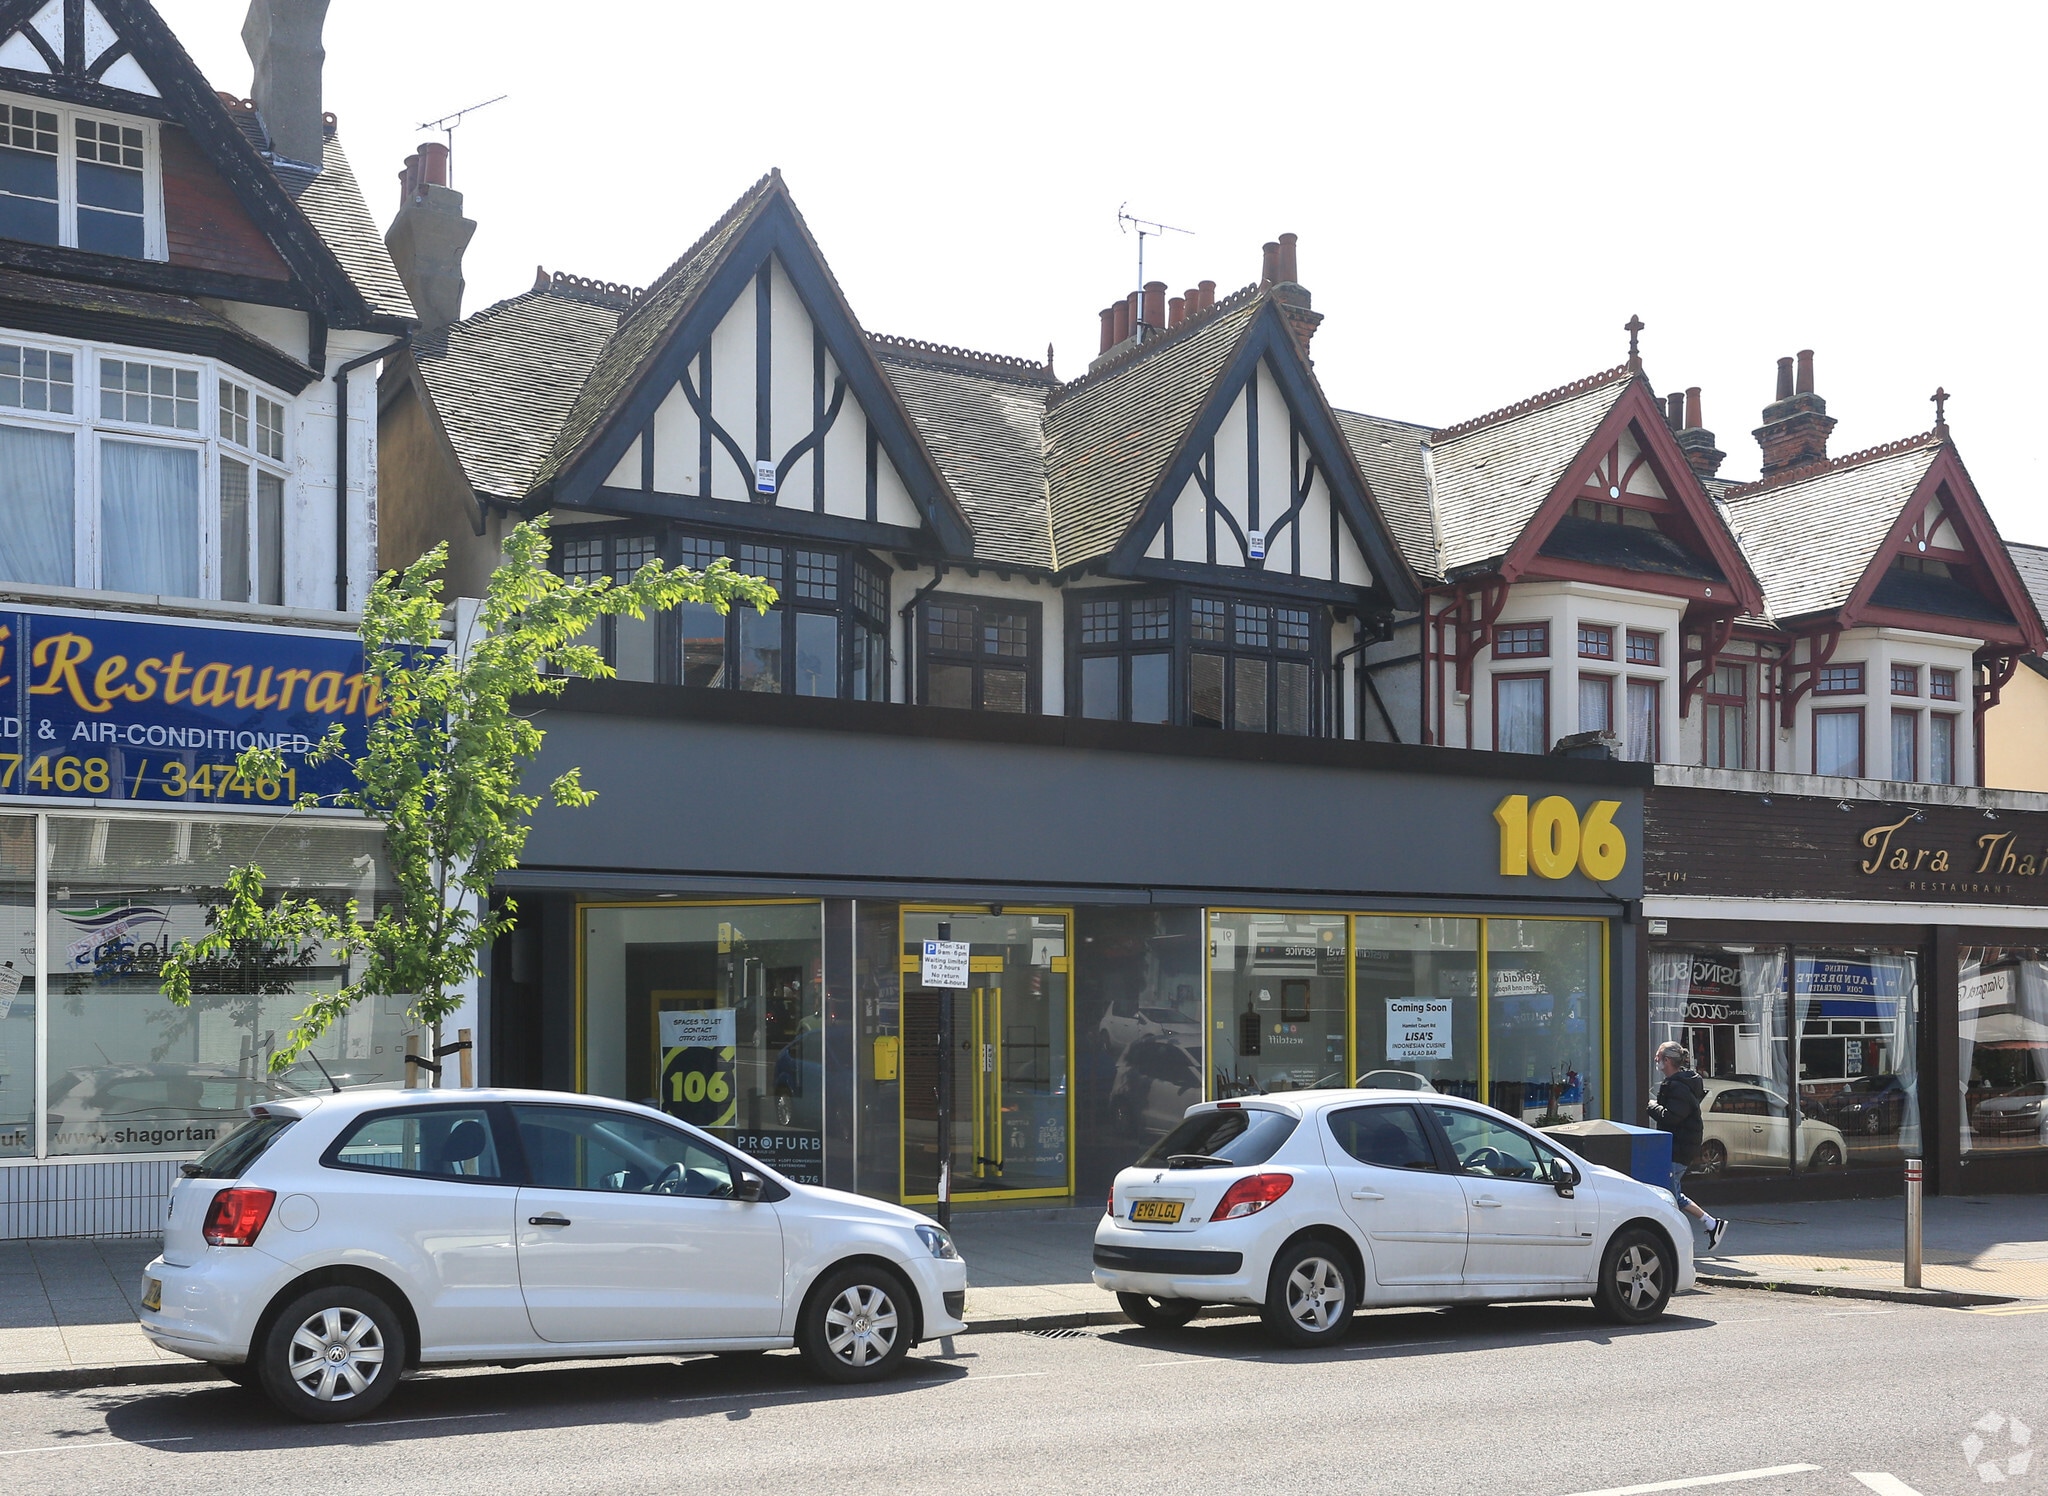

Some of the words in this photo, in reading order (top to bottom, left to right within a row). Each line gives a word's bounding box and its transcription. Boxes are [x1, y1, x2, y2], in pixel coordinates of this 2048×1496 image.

[0, 717, 22, 738] D
[37, 719, 56, 740] &
[72, 721, 310, 754] AIR-CONDITIONED
[161, 761, 296, 801] 347461
[1493, 794, 1627, 881] 106
[1862, 815, 1949, 875] Tara
[1975, 830, 2048, 876] Thai
[1667, 872, 1687, 881] 104
[1910, 881, 2012, 894] RESTAURANT
[1391, 1003, 1424, 1013] Coming
[1426, 1003, 1447, 1012] Soon
[673, 1018, 699, 1026] SPACES
[1405, 1032, 1433, 1041] LISA'S
[670, 1070, 729, 1103] 106
[1, 1131, 27, 1146] uk
[737, 1136, 821, 1150] PROFURB
[799, 1175, 818, 1183] 376
[1137, 1203, 1158, 1217] EY61
[1157, 1204, 1177, 1218] LGL
